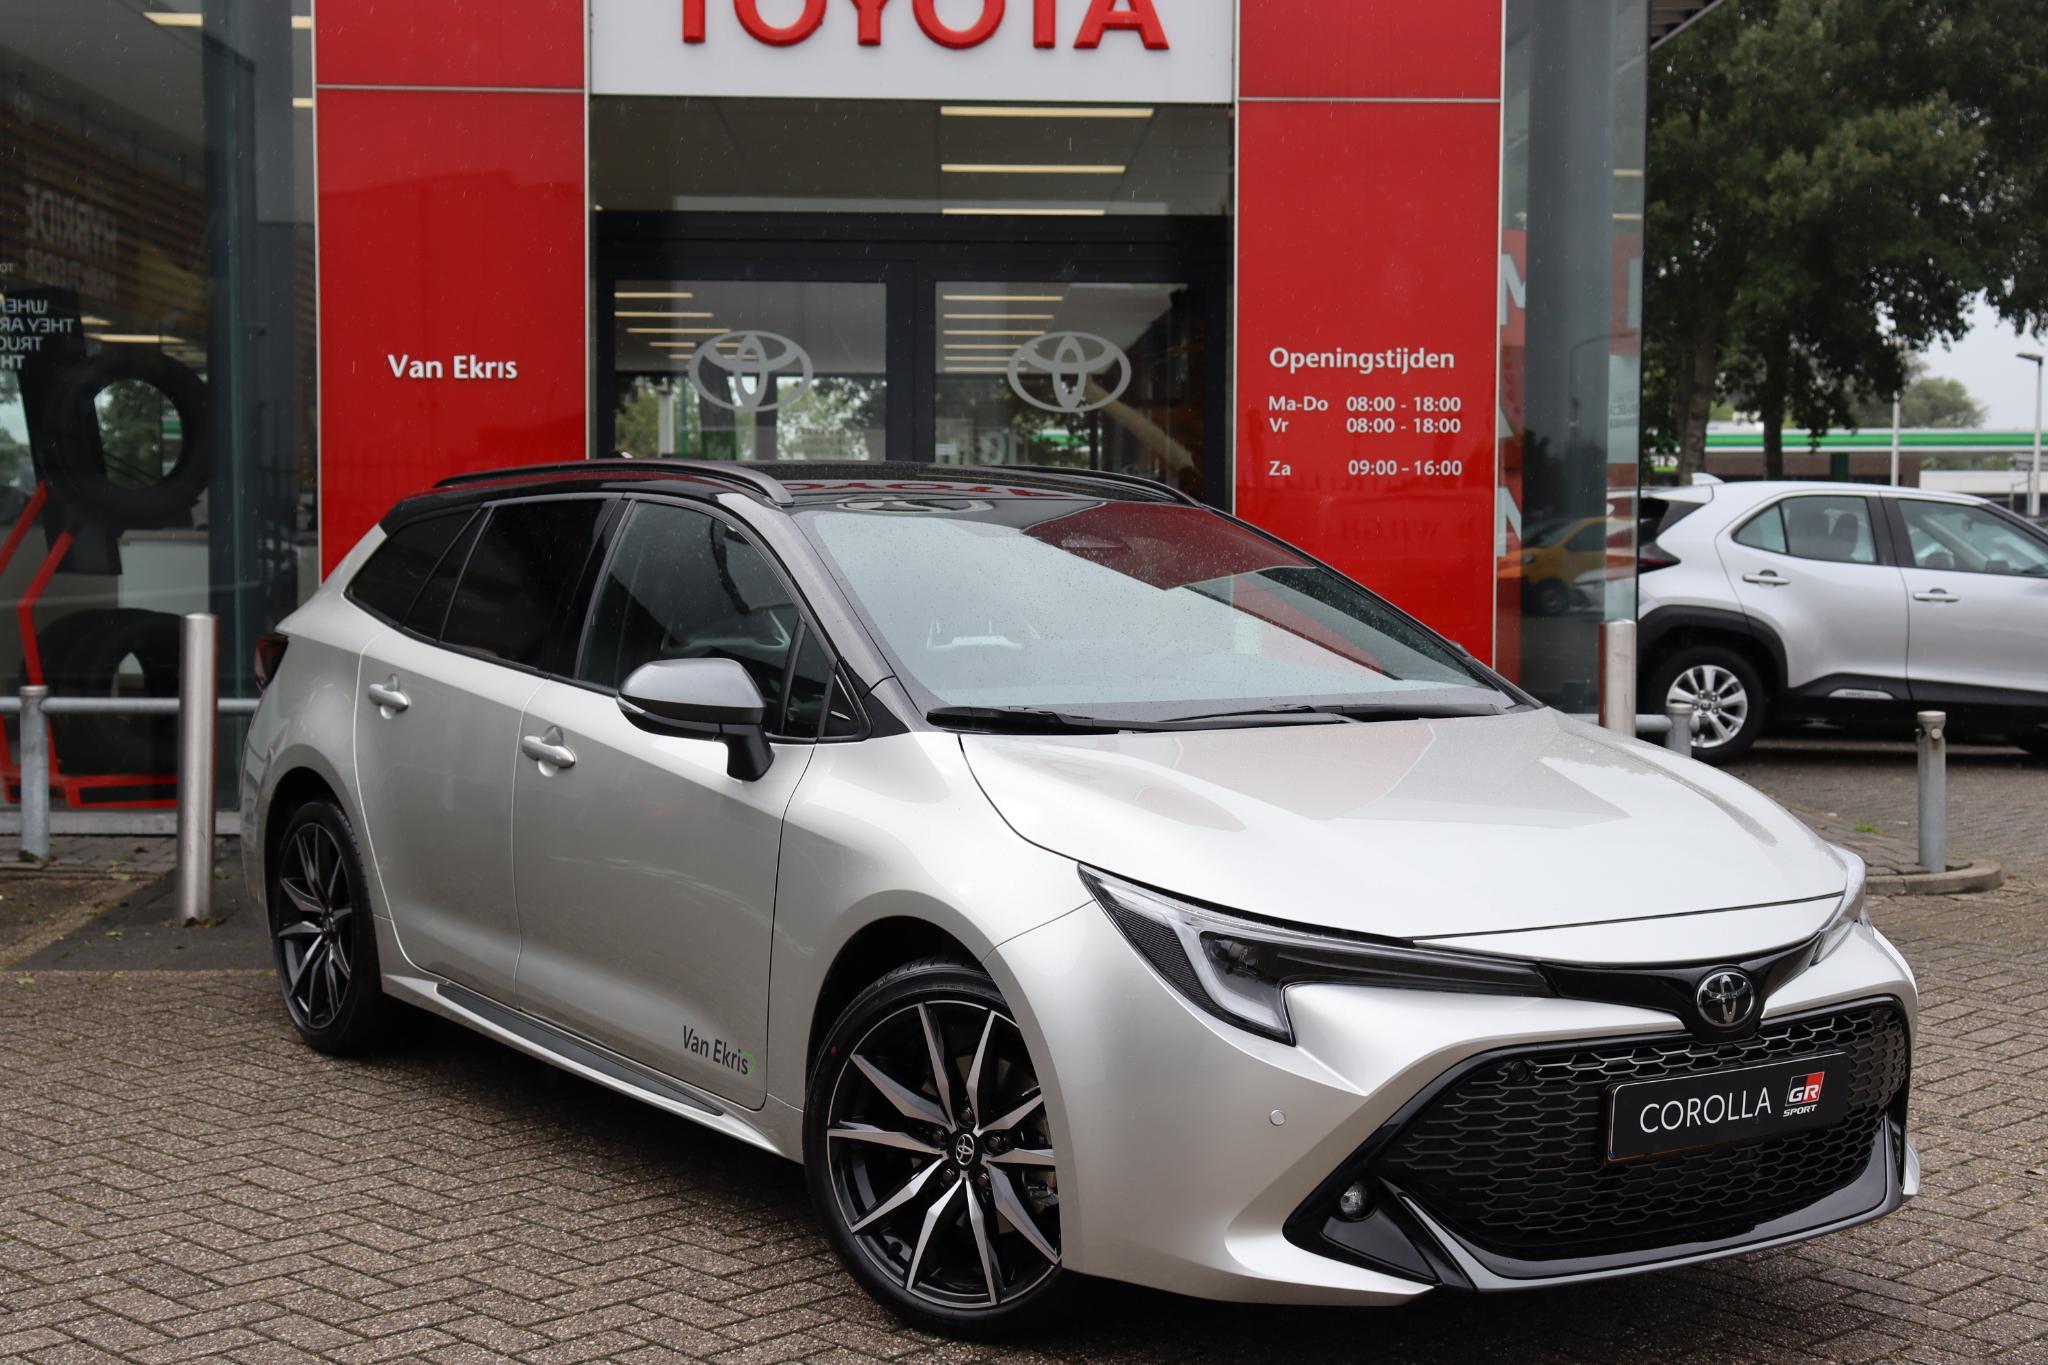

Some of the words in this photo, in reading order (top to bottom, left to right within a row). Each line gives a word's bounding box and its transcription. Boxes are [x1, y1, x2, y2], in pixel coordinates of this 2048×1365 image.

[388, 354, 443, 378] Van
[453, 354, 518, 379] Ekris
[1269, 347, 1455, 374] Openingstijden
[1268, 396, 1329, 411] Ma-Do
[1346, 396, 1395, 412] 08:00
[1414, 396, 1461, 412] 18:00
[1269, 418, 1289, 433] Vr
[1346, 418, 1395, 433] 08:00
[1414, 418, 1461, 433] 18:00
[1269, 460, 1291, 476] Za
[1348, 460, 1397, 476] 09:00
[1414, 460, 1462, 476] 16:00
[683, 1025, 709, 1058] Van
[713, 1039, 749, 1076] Ekris
[1639, 1087, 1772, 1134] COROLLA
[1788, 1084, 1820, 1103] GR
[1782, 1104, 1818, 1118] SPORT
